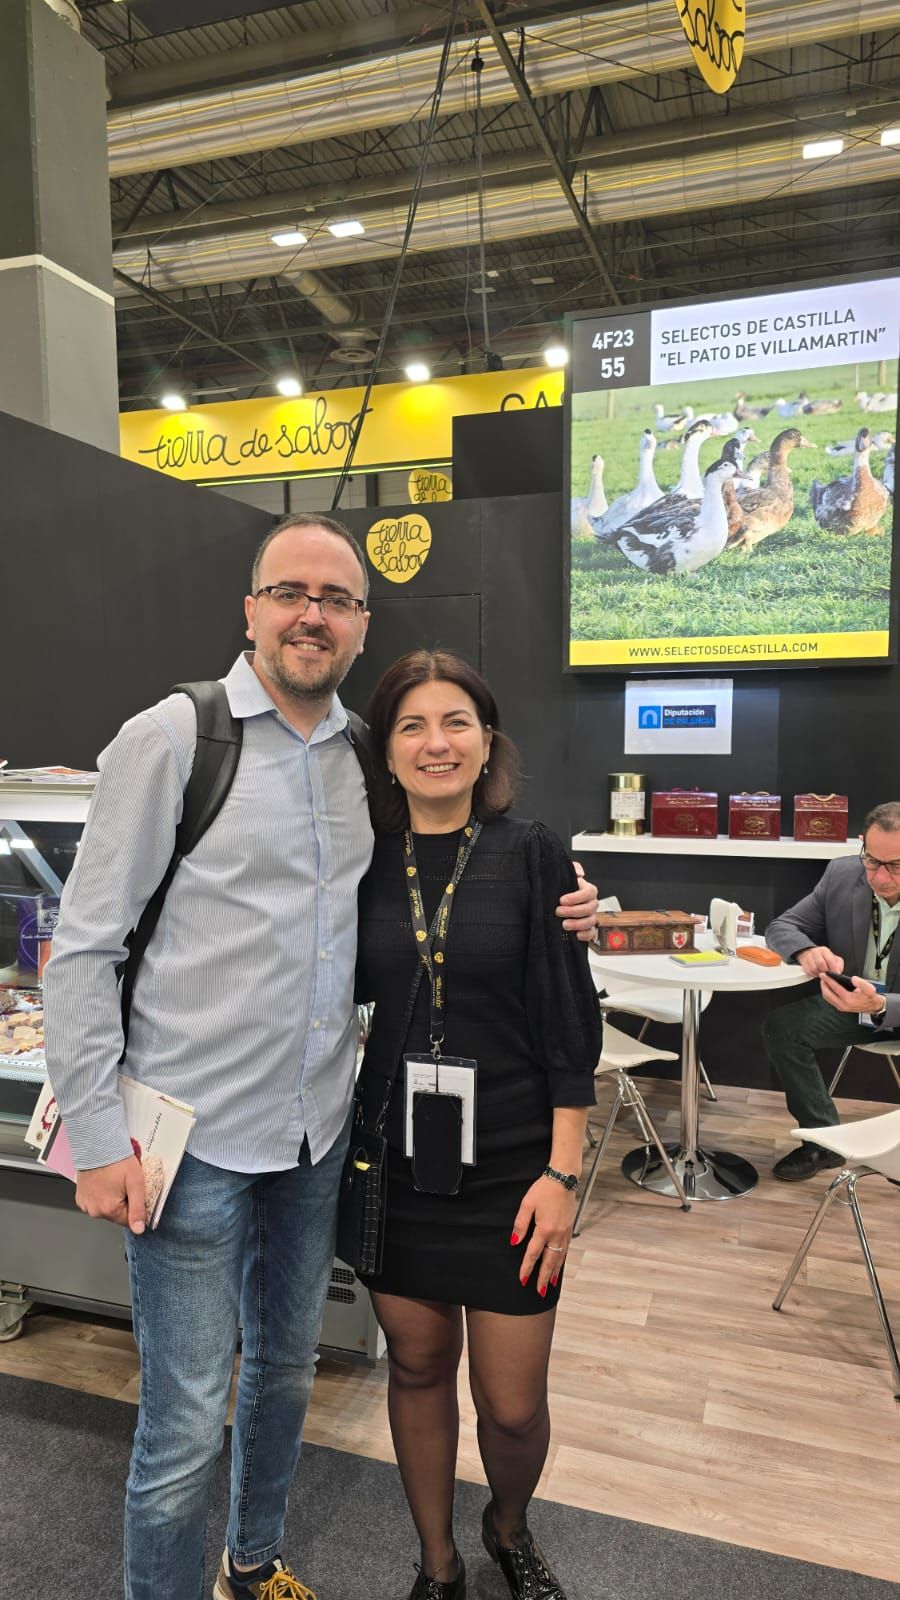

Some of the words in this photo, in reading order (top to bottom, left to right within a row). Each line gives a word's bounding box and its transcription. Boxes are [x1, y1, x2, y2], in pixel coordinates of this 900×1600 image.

[661, 323, 742, 345] SELECTOS
[748, 319, 768, 335] DE
[773, 308, 856, 331] CASTILLA
[592, 329, 634, 351] 4F23
[690, 346, 731, 364] PATO
[736, 342, 756, 358] DE
[601, 357, 625, 379] 55
[139, 430, 241, 470] tierra
[240, 429, 273, 458] de
[275, 397, 374, 458] sabor
[368, 521, 430, 543] tierra
[373, 541, 393, 556] de
[378, 541, 432, 574] sabor
[629, 642, 819, 657] WWW.SELECTOSDECASTILLA.COM
[664, 708, 705, 717] Diputación
